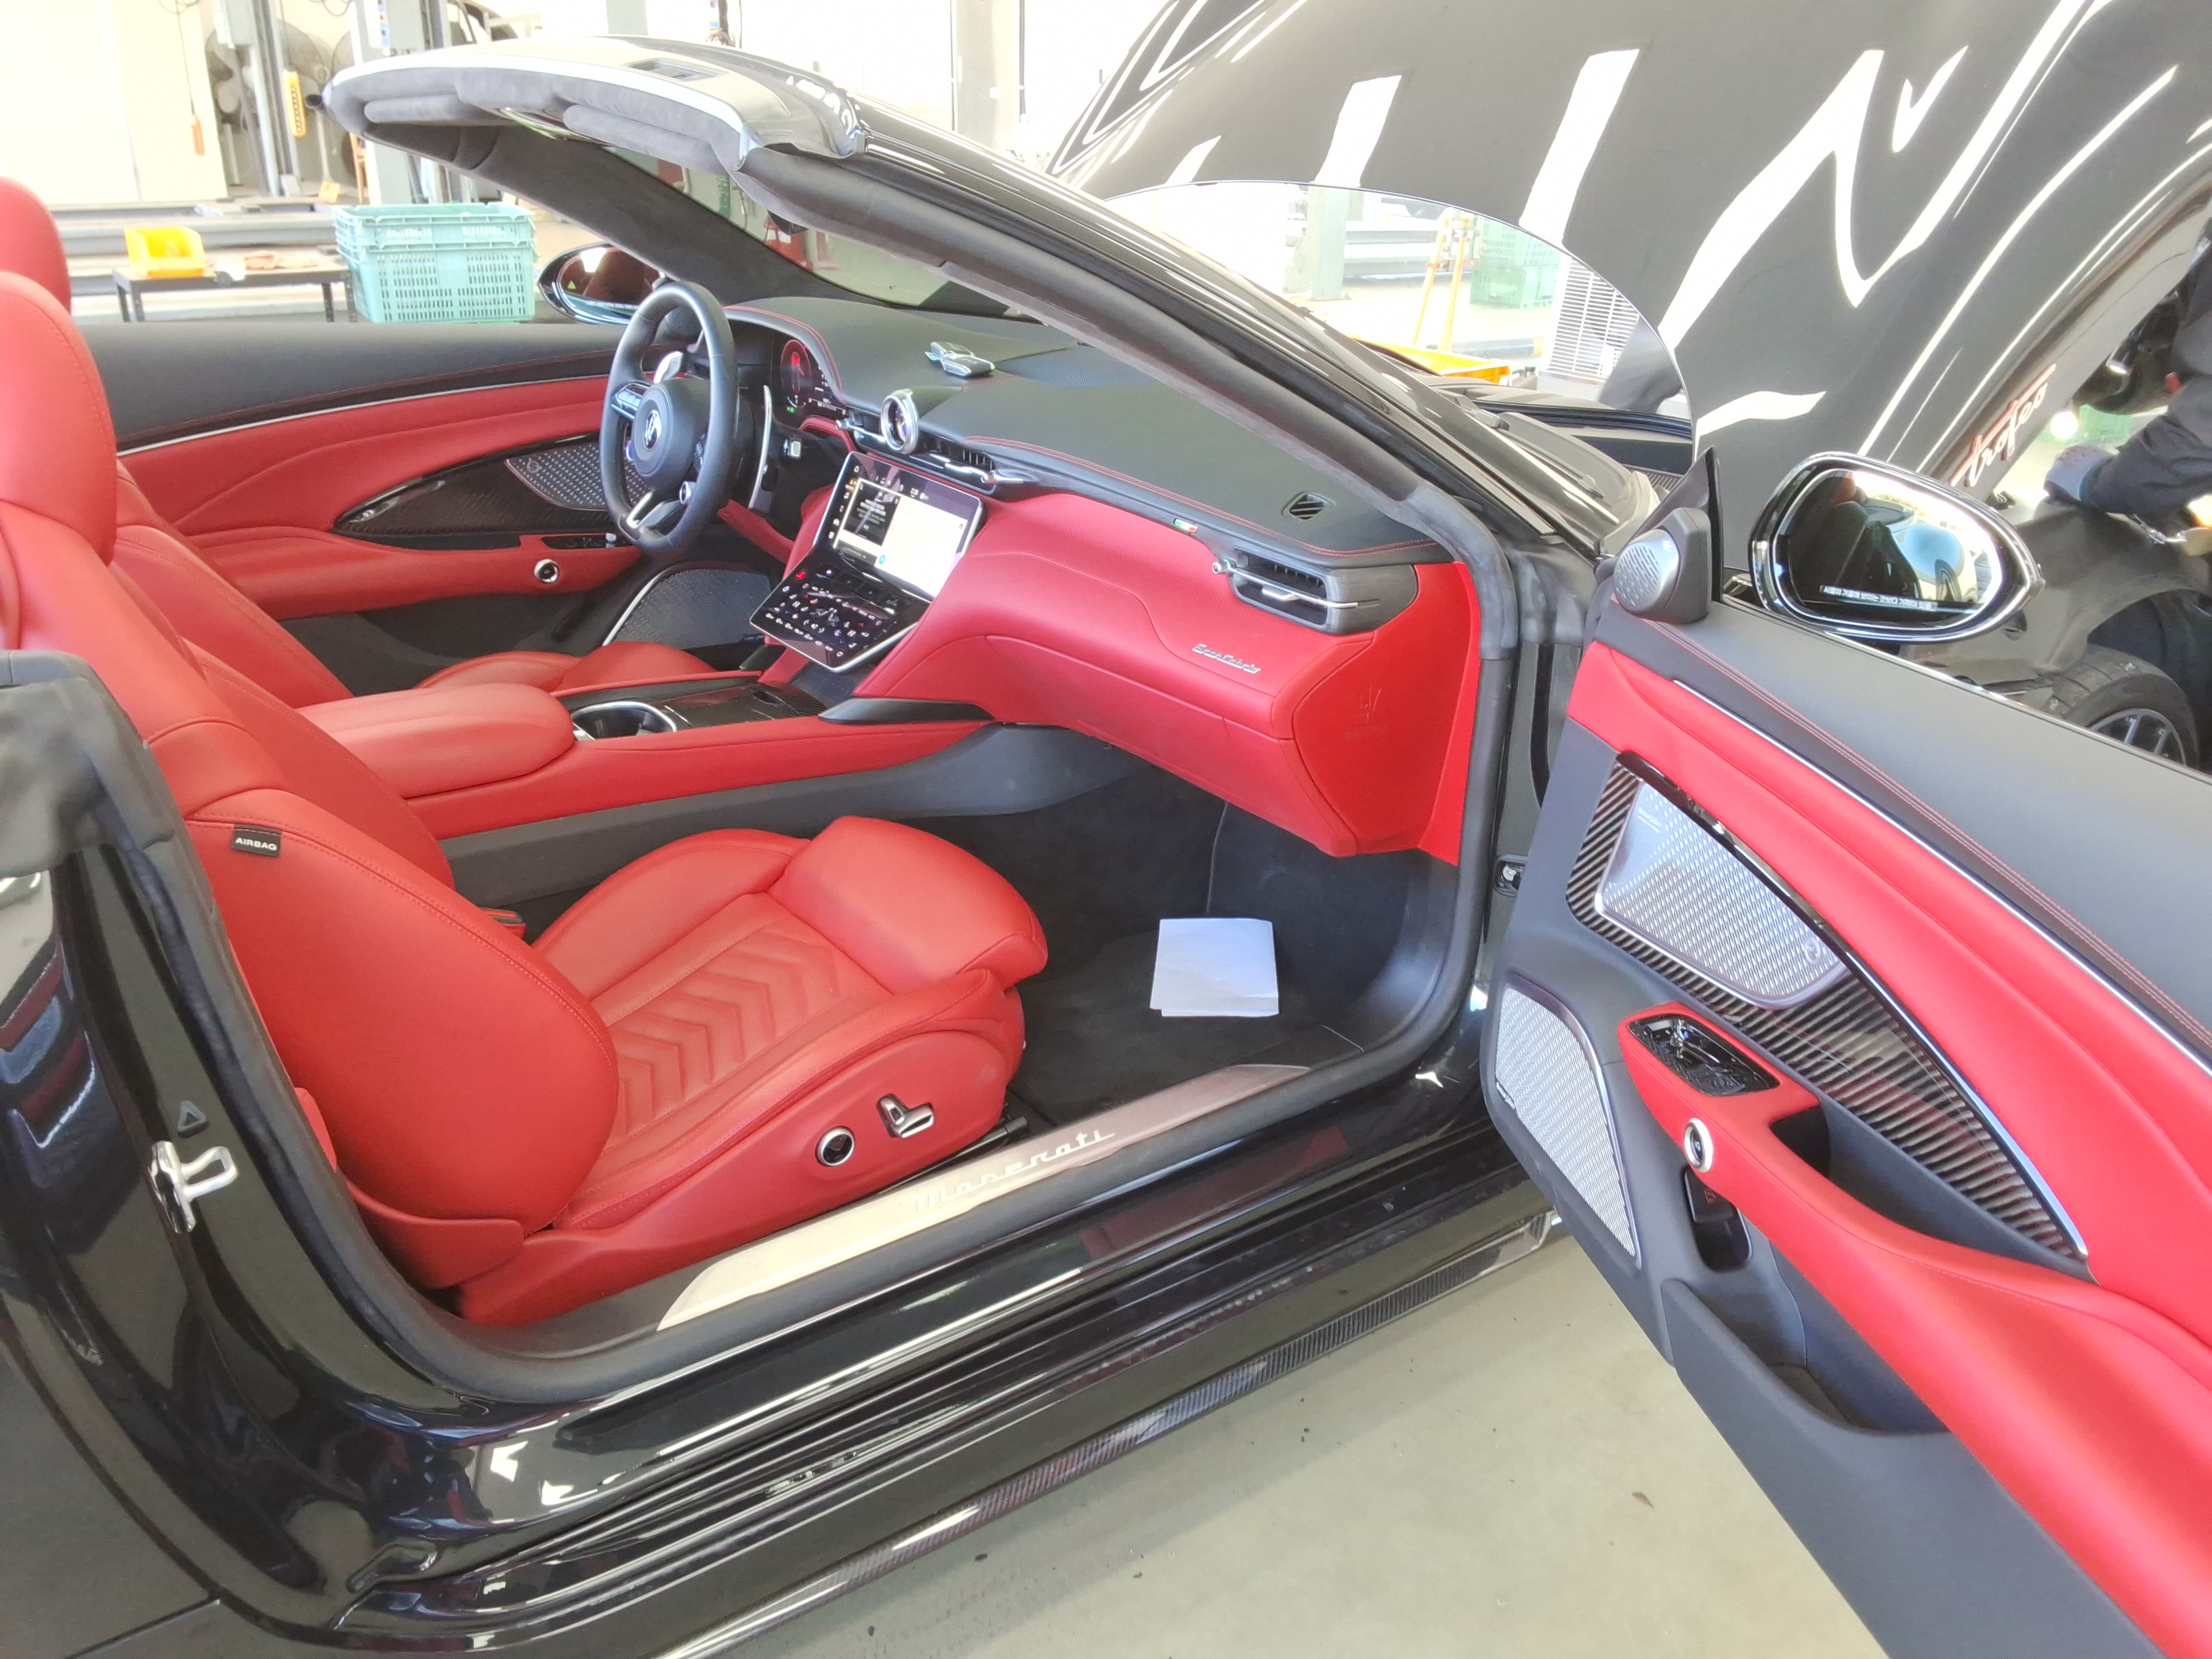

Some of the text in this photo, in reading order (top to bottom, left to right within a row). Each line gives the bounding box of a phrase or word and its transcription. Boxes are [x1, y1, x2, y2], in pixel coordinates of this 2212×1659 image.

[1949, 363, 2056, 487] trofeo
[235, 838, 277, 851] AIRBAG
[916, 1130, 1115, 1212] Maserati
